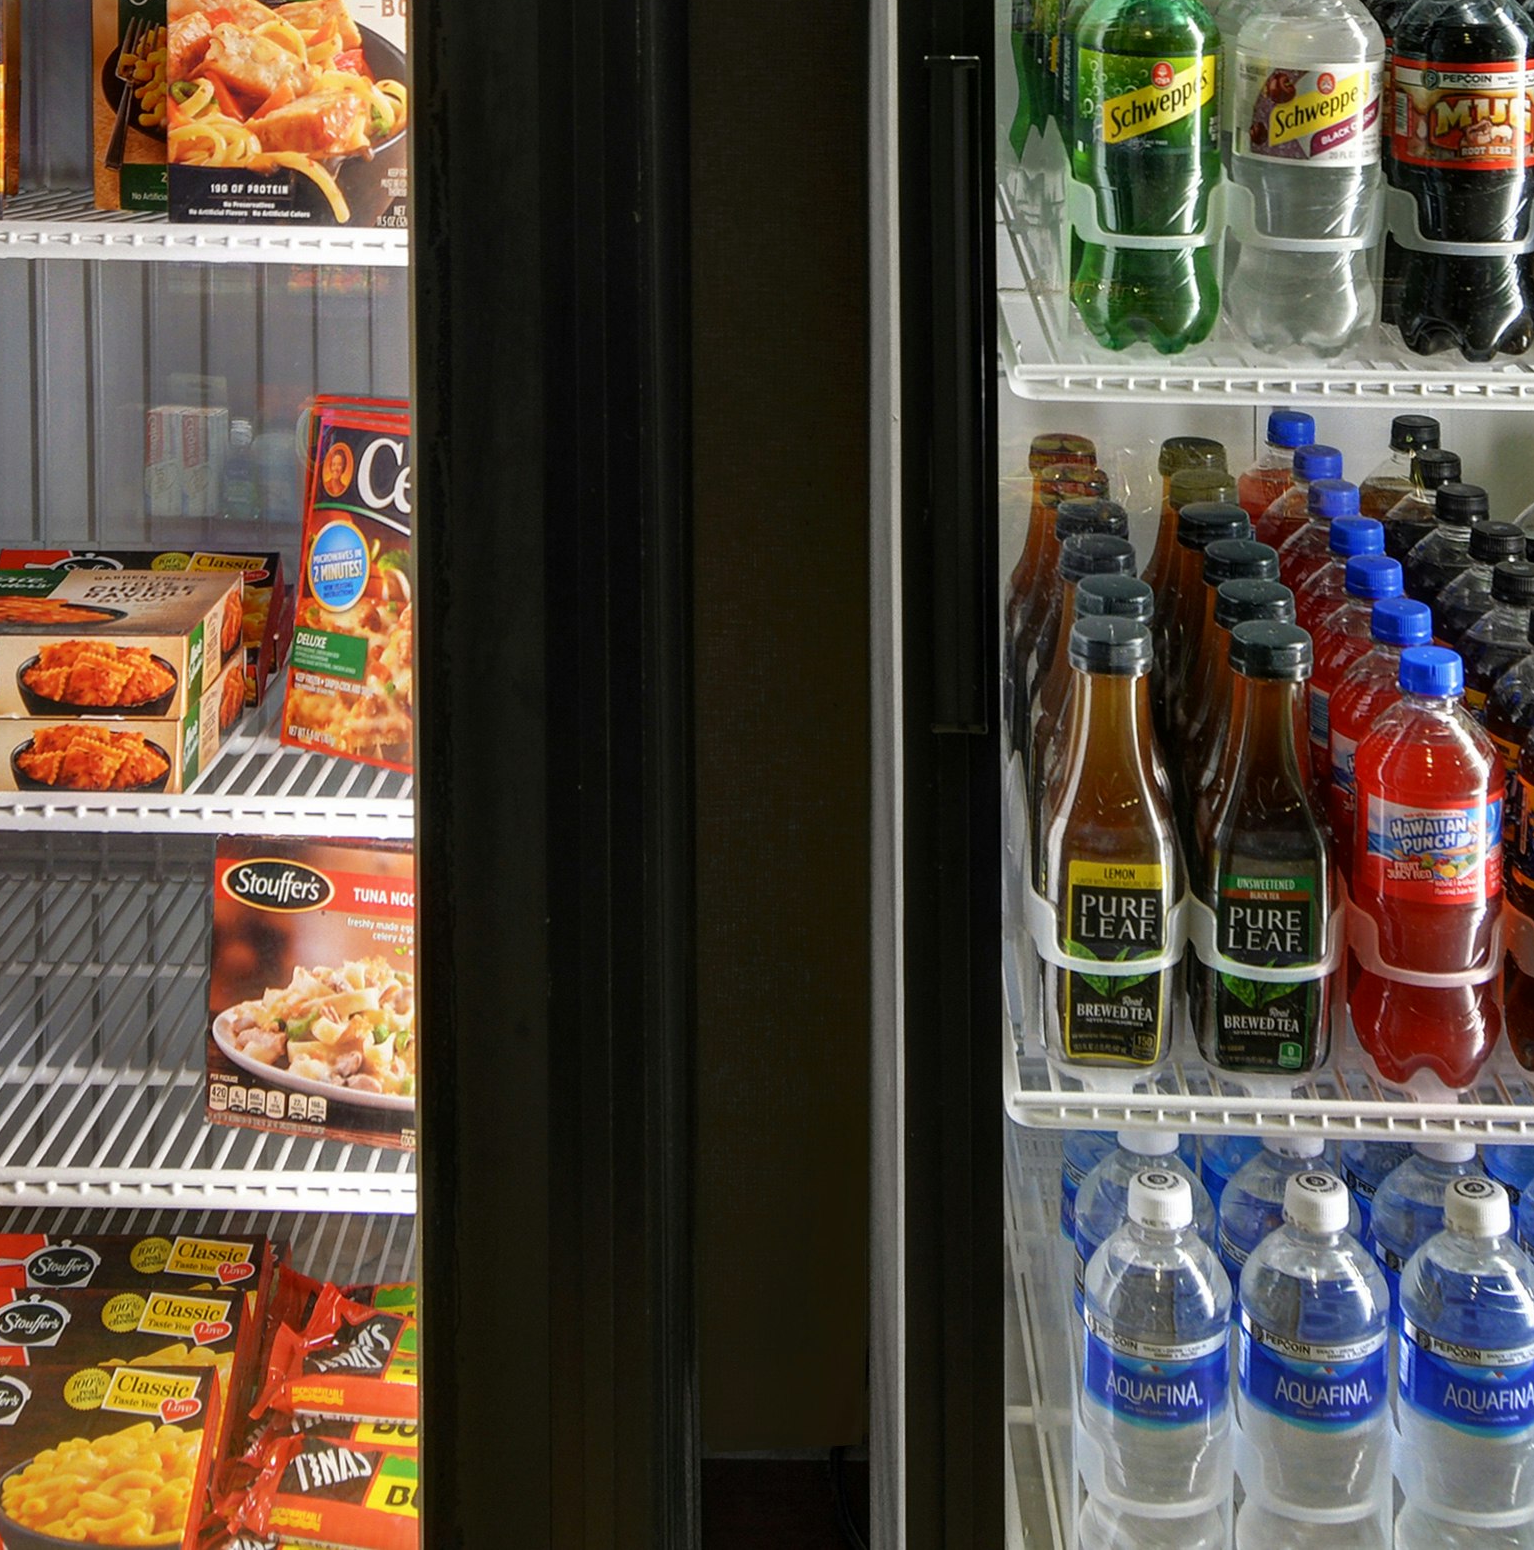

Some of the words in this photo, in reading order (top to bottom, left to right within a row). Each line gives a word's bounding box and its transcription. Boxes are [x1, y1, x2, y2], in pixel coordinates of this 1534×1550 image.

[1442, 74, 1492, 84] PEPCOIN
[1111, 68, 1208, 138] Schweppes
[1436, 96, 1533, 137] MUG
[1462, 146, 1486, 155] ROOT
[1489, 145, 1512, 155] BEER
[231, 184, 243, 195] OF
[247, 184, 288, 195] PROTEIN
[313, 569, 319, 582] 2
[321, 560, 363, 581] MINUTES!
[296, 632, 328, 649] DELUXE
[1391, 817, 1467, 841] HAWAIIAN
[1401, 832, 1457, 854] PUNCH
[1104, 868, 1136, 880] LEMON
[1387, 869, 1412, 880] JUICY
[1414, 869, 1433, 880] RED
[1394, 861, 1420, 872] FRUIT
[236, 868, 320, 903] Stouffer's
[1237, 878, 1296, 891] UNSWEETENED
[353, 887, 387, 904] TUNA
[1080, 894, 1157, 918] PURE
[1229, 906, 1302, 931] PURE
[1080, 917, 1154, 941] LEAF
[1228, 928, 1299, 952] LEAF
[1076, 1003, 1128, 1019] BREWED
[1130, 1008, 1153, 1021] TEA
[1224, 1015, 1275, 1031] BREWED
[1276, 1020, 1299, 1033] TEA
[212, 1087, 227, 1099] 420
[137, 1245, 167, 1256] 100%
[178, 1242, 244, 1263] Classic
[32, 1256, 91, 1277] Stouffer's
[174, 1260, 197, 1270] Taste
[199, 1262, 216, 1272] You
[224, 1264, 247, 1276] Love
[108, 1301, 141, 1313] 100%
[151, 1299, 221, 1322] Classic
[147, 1319, 171, 1329] Taste
[174, 1321, 191, 1332] You
[198, 1324, 224, 1336] Love
[1265, 1332, 1311, 1357] PEPCOIN
[1433, 1337, 1482, 1361] PEPCOIN
[72, 1376, 105, 1390] 100%
[116, 1375, 189, 1398] Classic
[1106, 1370, 1200, 1408] AQUAFINA
[1274, 1376, 1371, 1408] AQUAFINA
[112, 1396, 139, 1407] Taste
[141, 1399, 158, 1410] You
[166, 1401, 193, 1412] Love
